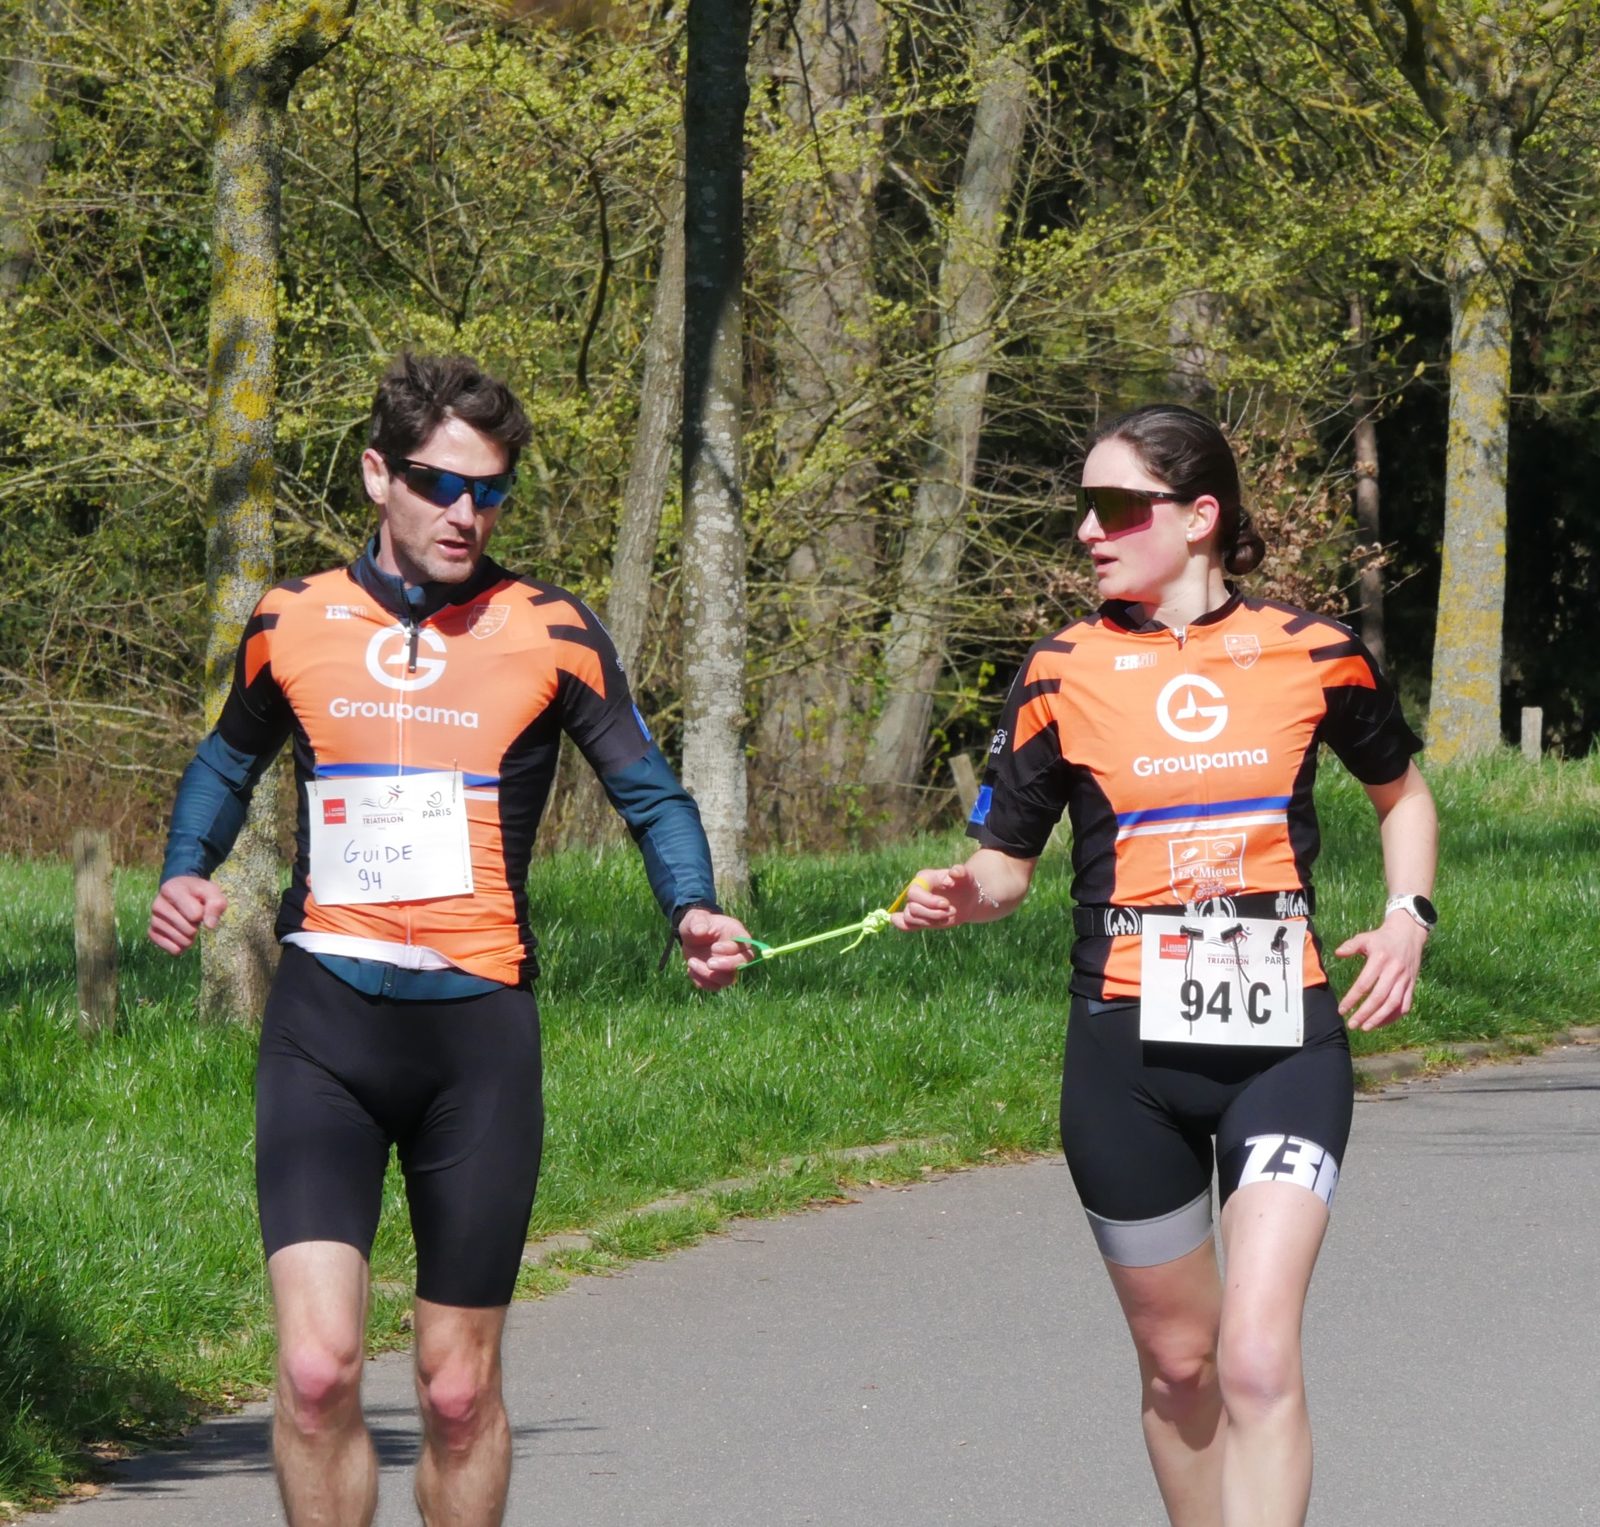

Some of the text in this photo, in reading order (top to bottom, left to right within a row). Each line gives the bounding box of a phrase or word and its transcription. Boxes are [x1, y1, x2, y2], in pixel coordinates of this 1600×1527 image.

[329, 697, 479, 728] Groupama
[1133, 748, 1268, 777] Groupama
[362, 816, 404, 825] TRIATHLON
[422, 808, 452, 818] PARIS
[358, 868, 382, 891] 94
[1264, 956, 1290, 965] PARS
[1180, 979, 1271, 1025] 94 C
